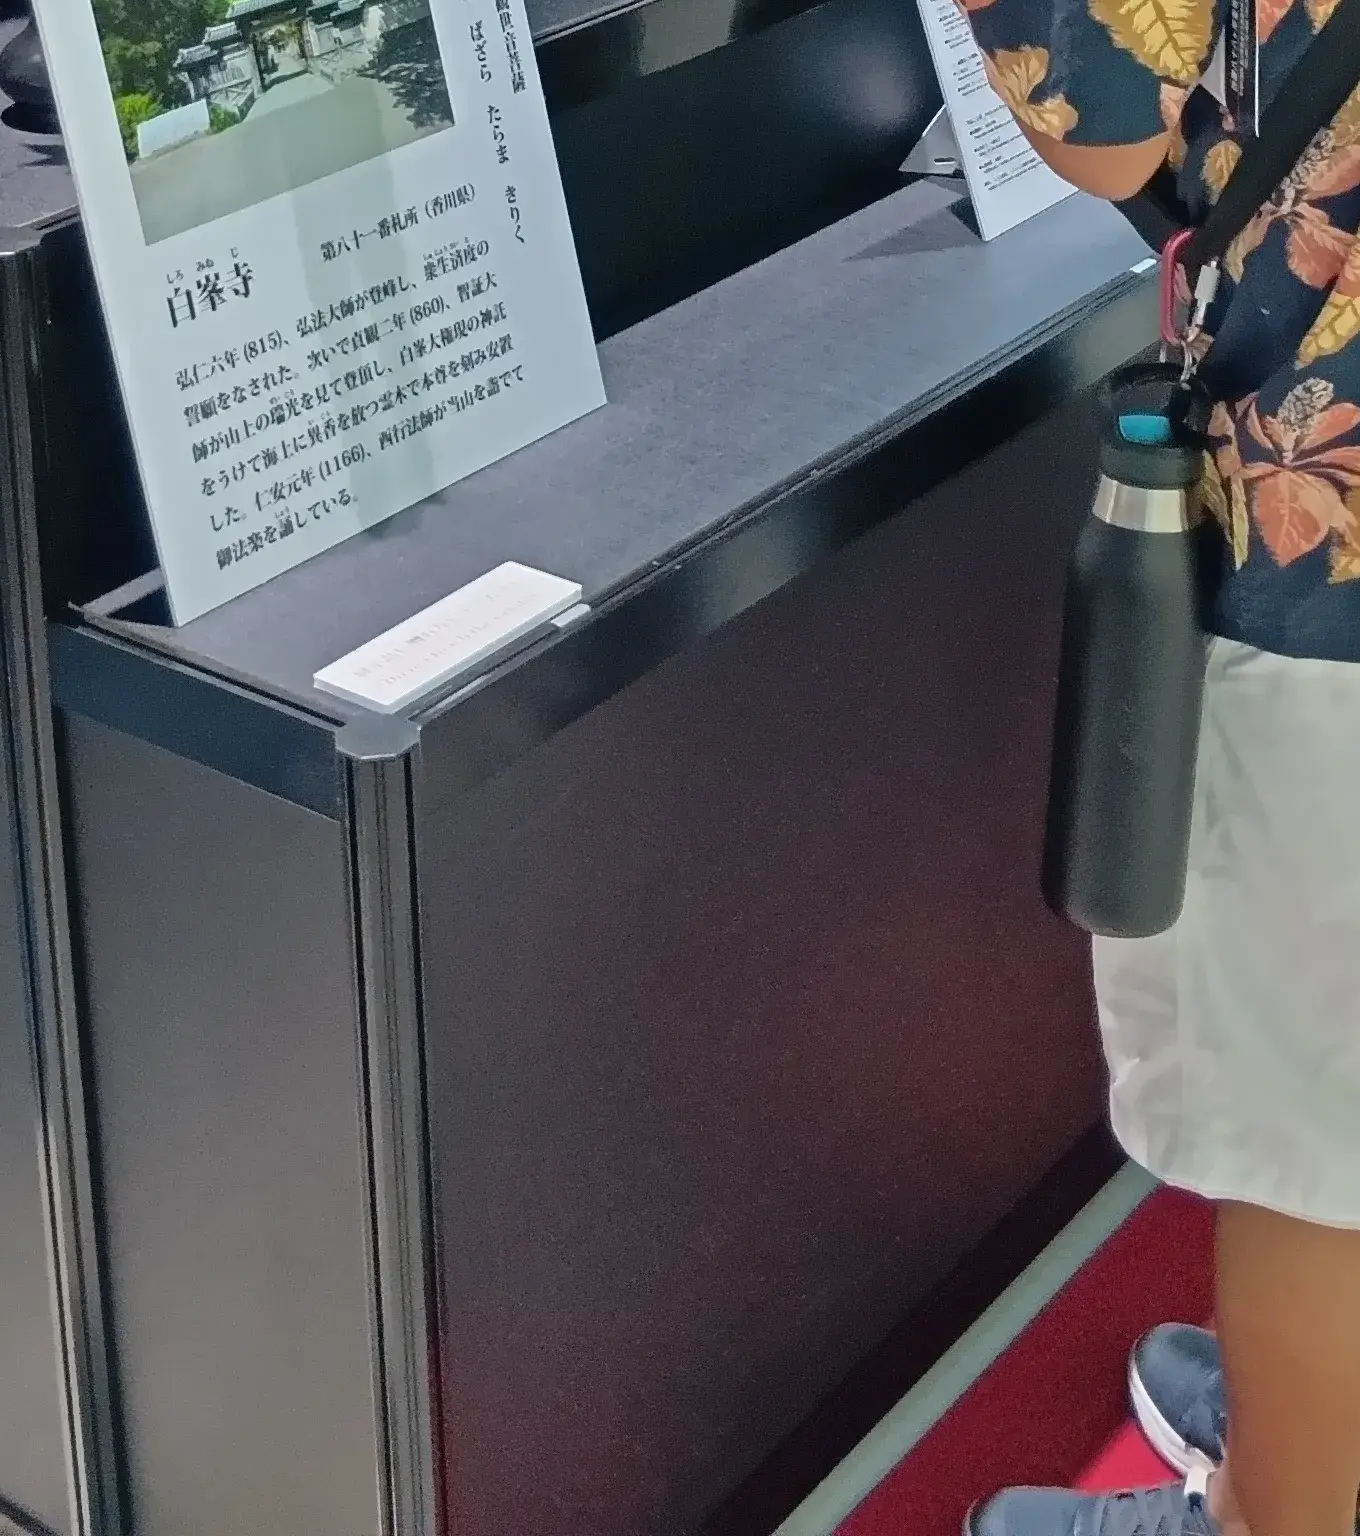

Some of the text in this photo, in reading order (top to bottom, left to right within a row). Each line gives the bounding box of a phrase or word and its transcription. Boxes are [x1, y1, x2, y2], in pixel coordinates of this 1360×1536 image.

[486, 104, 510, 165] たらま
[504, 184, 525, 244] きりく
[166, 260, 255, 328] 白峯寺
